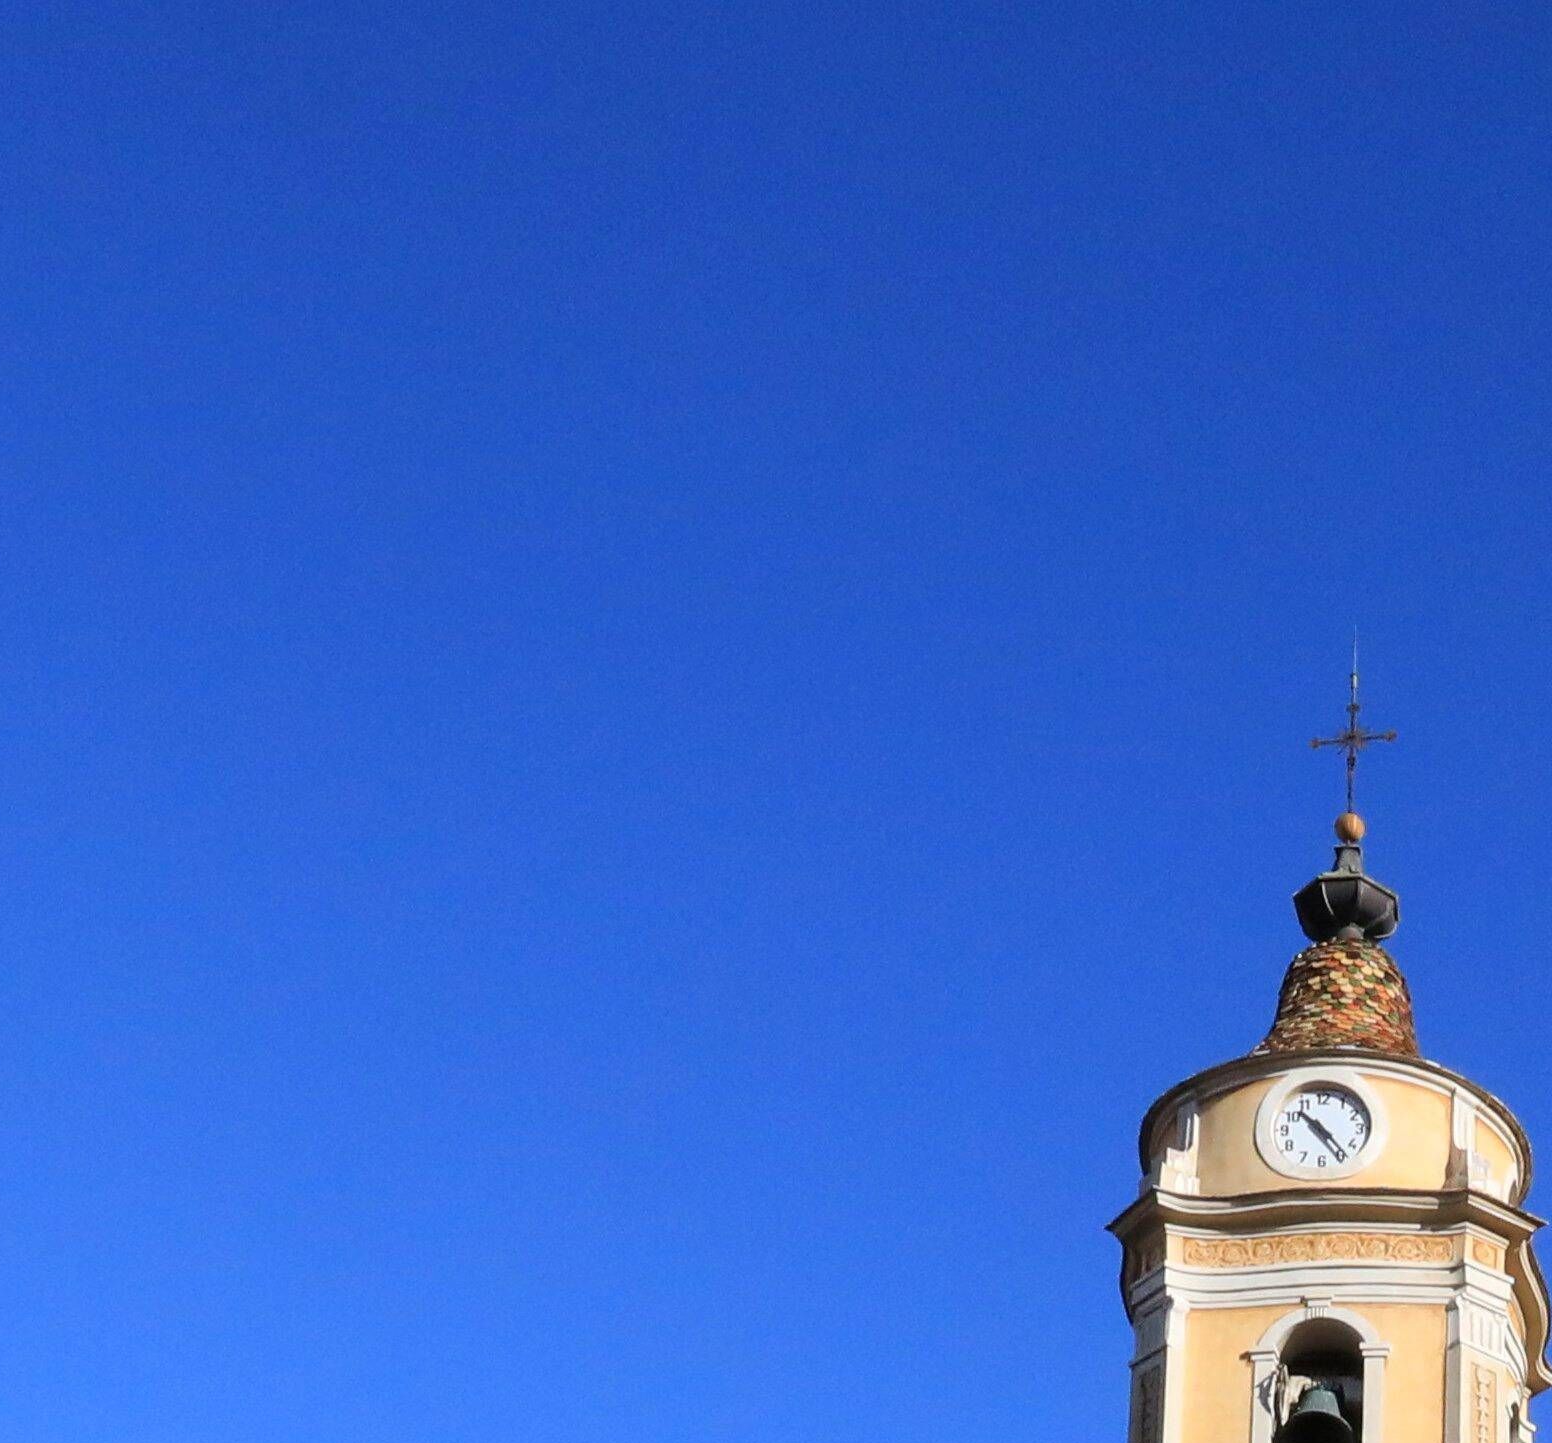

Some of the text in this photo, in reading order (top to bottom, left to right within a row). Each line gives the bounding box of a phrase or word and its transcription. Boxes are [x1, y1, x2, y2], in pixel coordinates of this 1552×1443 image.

[1316, 1092, 1330, 1105] 12
[1298, 1099, 1310, 1112] 11
[1286, 1111, 1301, 1123] 10
[1350, 1109, 1360, 1121] 2
[1280, 1125, 1289, 1136] 9
[1355, 1122, 1365, 1134] 3
[1284, 1139, 1294, 1151] 8
[1348, 1138, 1357, 1149] 4
[1298, 1151, 1308, 1163] 7
[1317, 1154, 1327, 1167] 6
